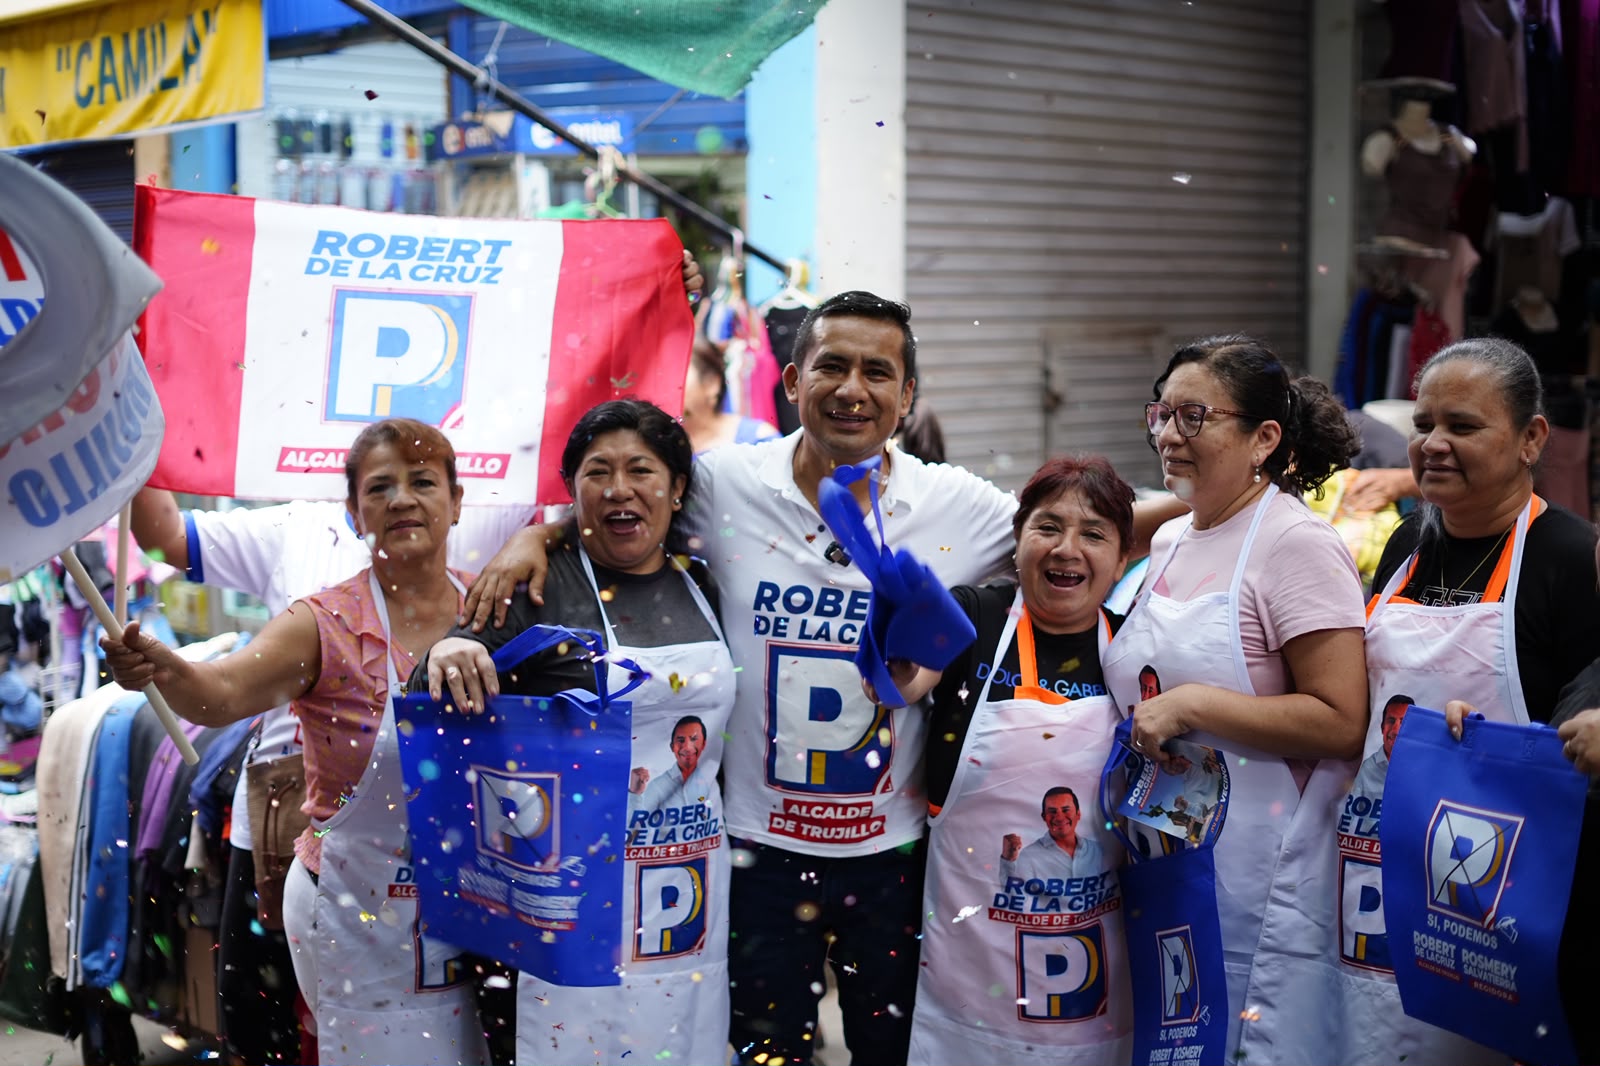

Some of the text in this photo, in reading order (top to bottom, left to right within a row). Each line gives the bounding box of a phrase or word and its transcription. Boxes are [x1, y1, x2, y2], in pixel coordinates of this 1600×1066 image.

[311, 230, 512, 264] ROBERT
[304, 258, 503, 284] DE LA CRUZ
[282, 450, 347, 468] ALCAL
[753, 580, 873, 621] ROBE
[754, 615, 790, 637] DE
[798, 619, 831, 641] LA
[976, 662, 1022, 688] DOLC
[788, 804, 872, 820] ALCALDE
[652, 828, 677, 845] LA
[682, 818, 719, 841] CRUZ
[771, 817, 882, 839] DE TRUJILLO
[624, 845, 667, 858] LCALDE
[1340, 836, 1371, 852] ALDE
[1005, 871, 1110, 897] ROBERT
[993, 893, 1025, 912] DE
[1031, 896, 1061, 913] LA
[992, 910, 1049, 926] ALCALDE
[1053, 914, 1071, 925] DE
[1413, 930, 1456, 959] ROBERT
[1443, 919, 1498, 950] PODEMOS
[1462, 948, 1518, 980] ROSMERY
[1168, 1026, 1198, 1040] PODEMOS
